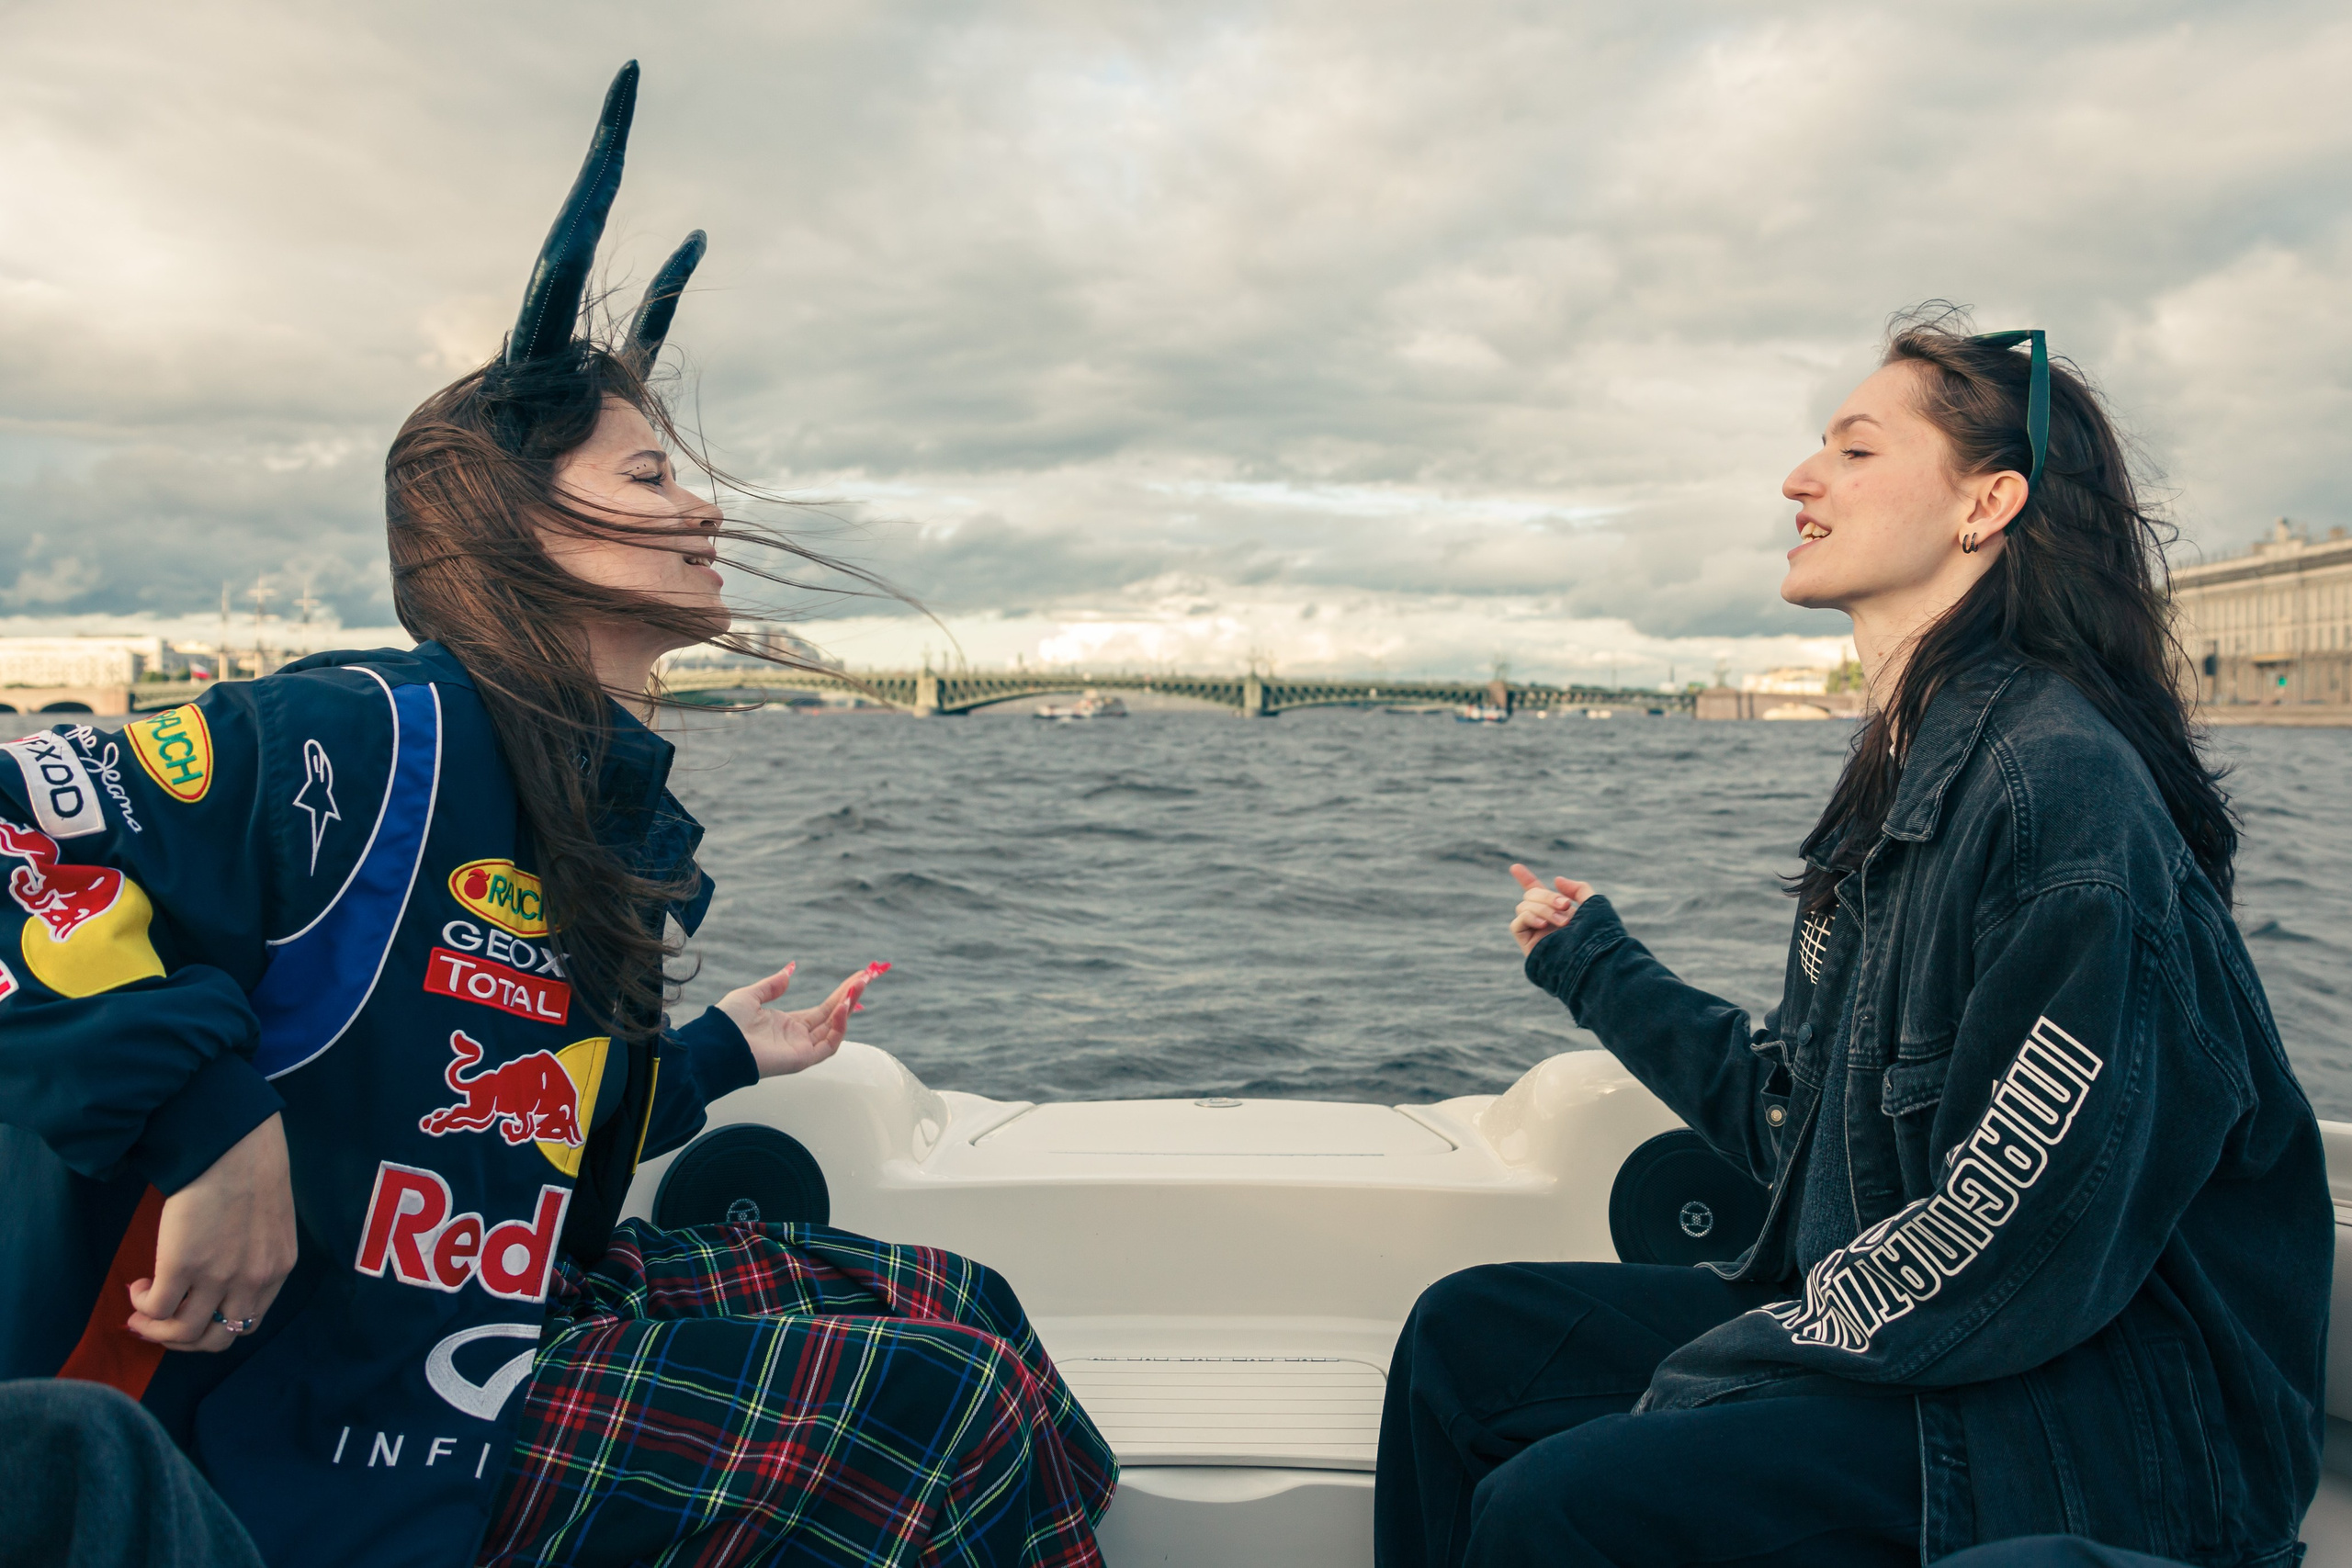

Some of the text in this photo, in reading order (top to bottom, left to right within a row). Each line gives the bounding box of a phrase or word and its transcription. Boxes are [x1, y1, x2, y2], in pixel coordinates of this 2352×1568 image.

[145, 711, 204, 785] RAUCH
[79, 741, 143, 833] Jeans
[442, 920, 570, 977] GEOX
[440, 955, 561, 1019] TOTAL
[355, 1160, 572, 1303] Red
[333, 1426, 491, 1479] INFI
